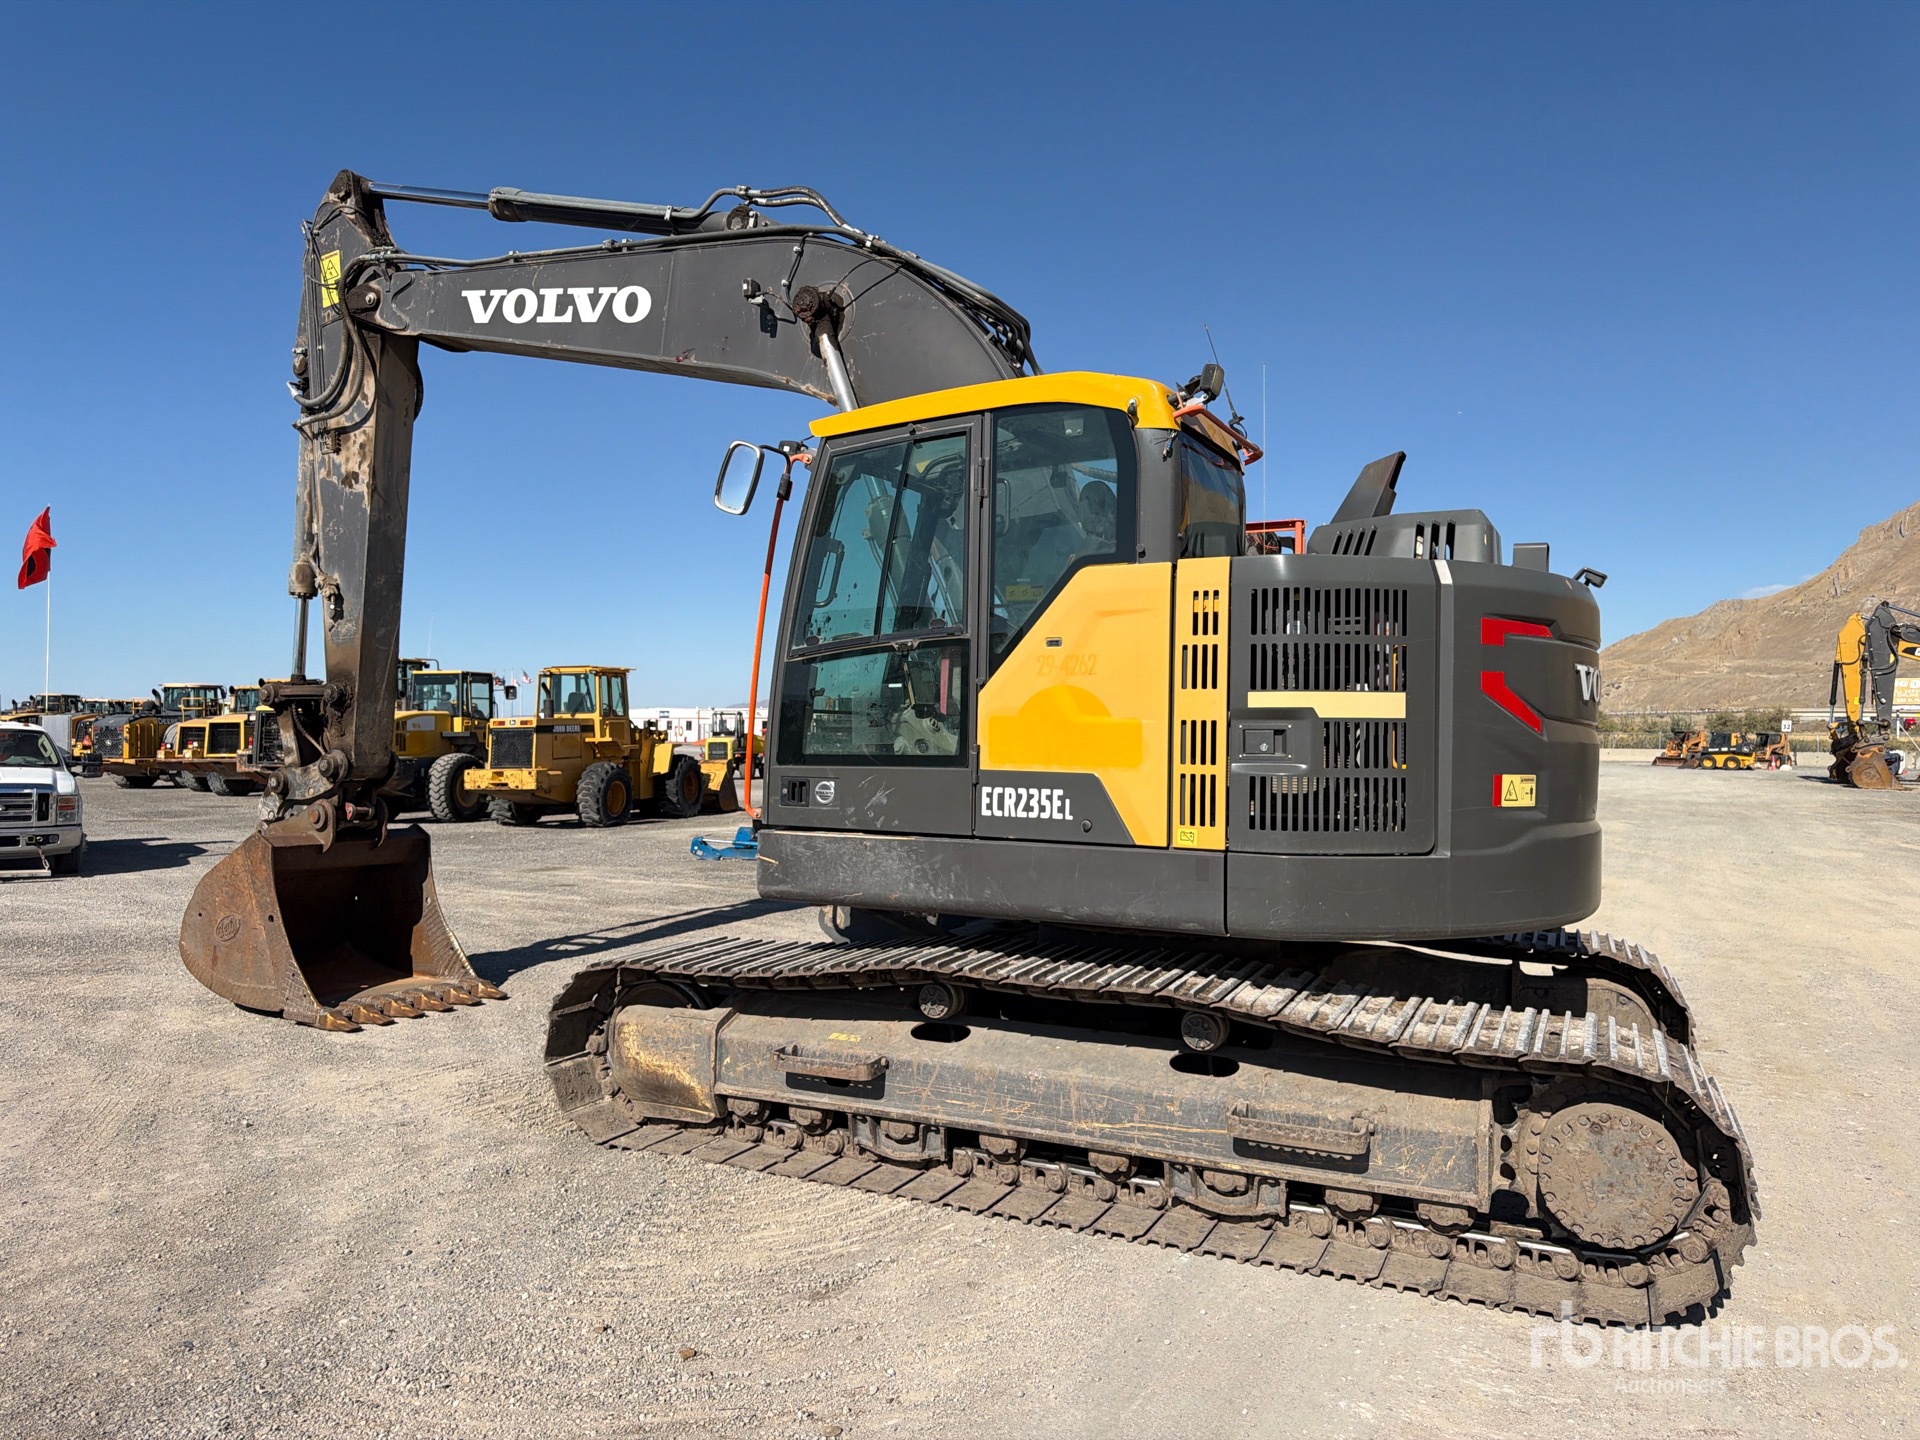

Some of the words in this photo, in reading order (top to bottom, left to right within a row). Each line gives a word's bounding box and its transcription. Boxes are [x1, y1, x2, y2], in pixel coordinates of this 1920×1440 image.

[461, 285, 652, 324] VOLVO
[1036, 653, 1098, 677] 29-4262
[553, 725, 566, 733] JOHN
[566, 725, 581, 733] DEERE
